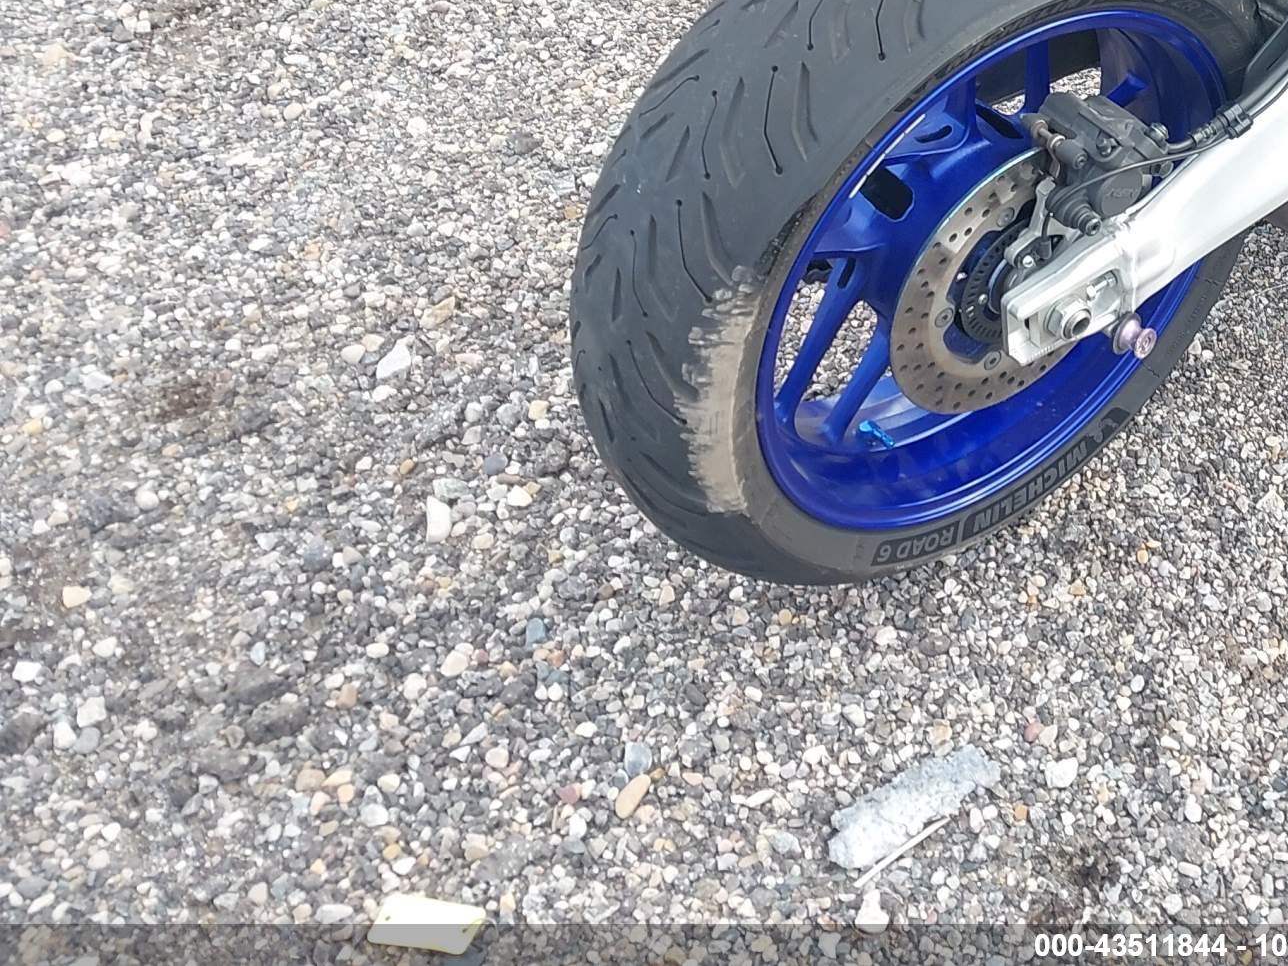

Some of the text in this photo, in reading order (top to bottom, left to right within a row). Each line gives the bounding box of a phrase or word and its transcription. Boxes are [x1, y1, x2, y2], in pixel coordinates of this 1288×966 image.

[972, 440, 1088, 533] MICHELIN
[876, 526, 955, 561] ROAD 6
